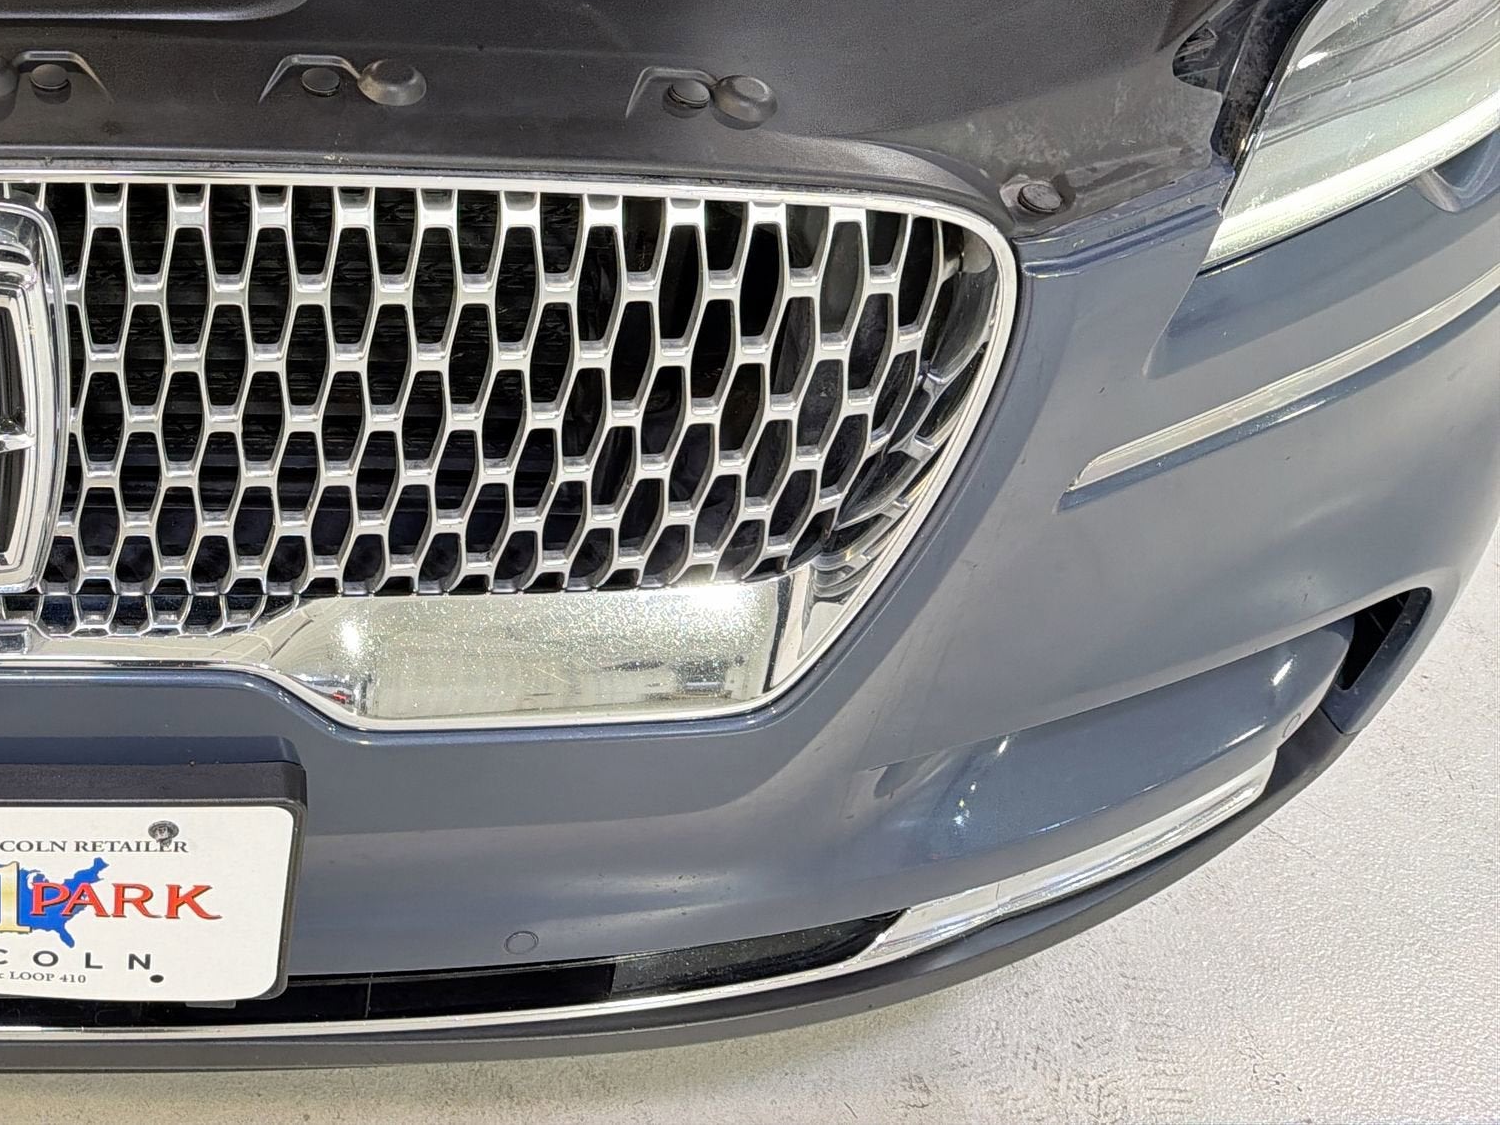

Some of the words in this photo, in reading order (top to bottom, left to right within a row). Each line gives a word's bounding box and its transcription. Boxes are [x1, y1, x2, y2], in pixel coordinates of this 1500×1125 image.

[73, 840, 189, 853] RETAILER
[30, 881, 223, 920] PARK
[9, 970, 56, 982] LOOP
[58, 973, 87, 984] 410
